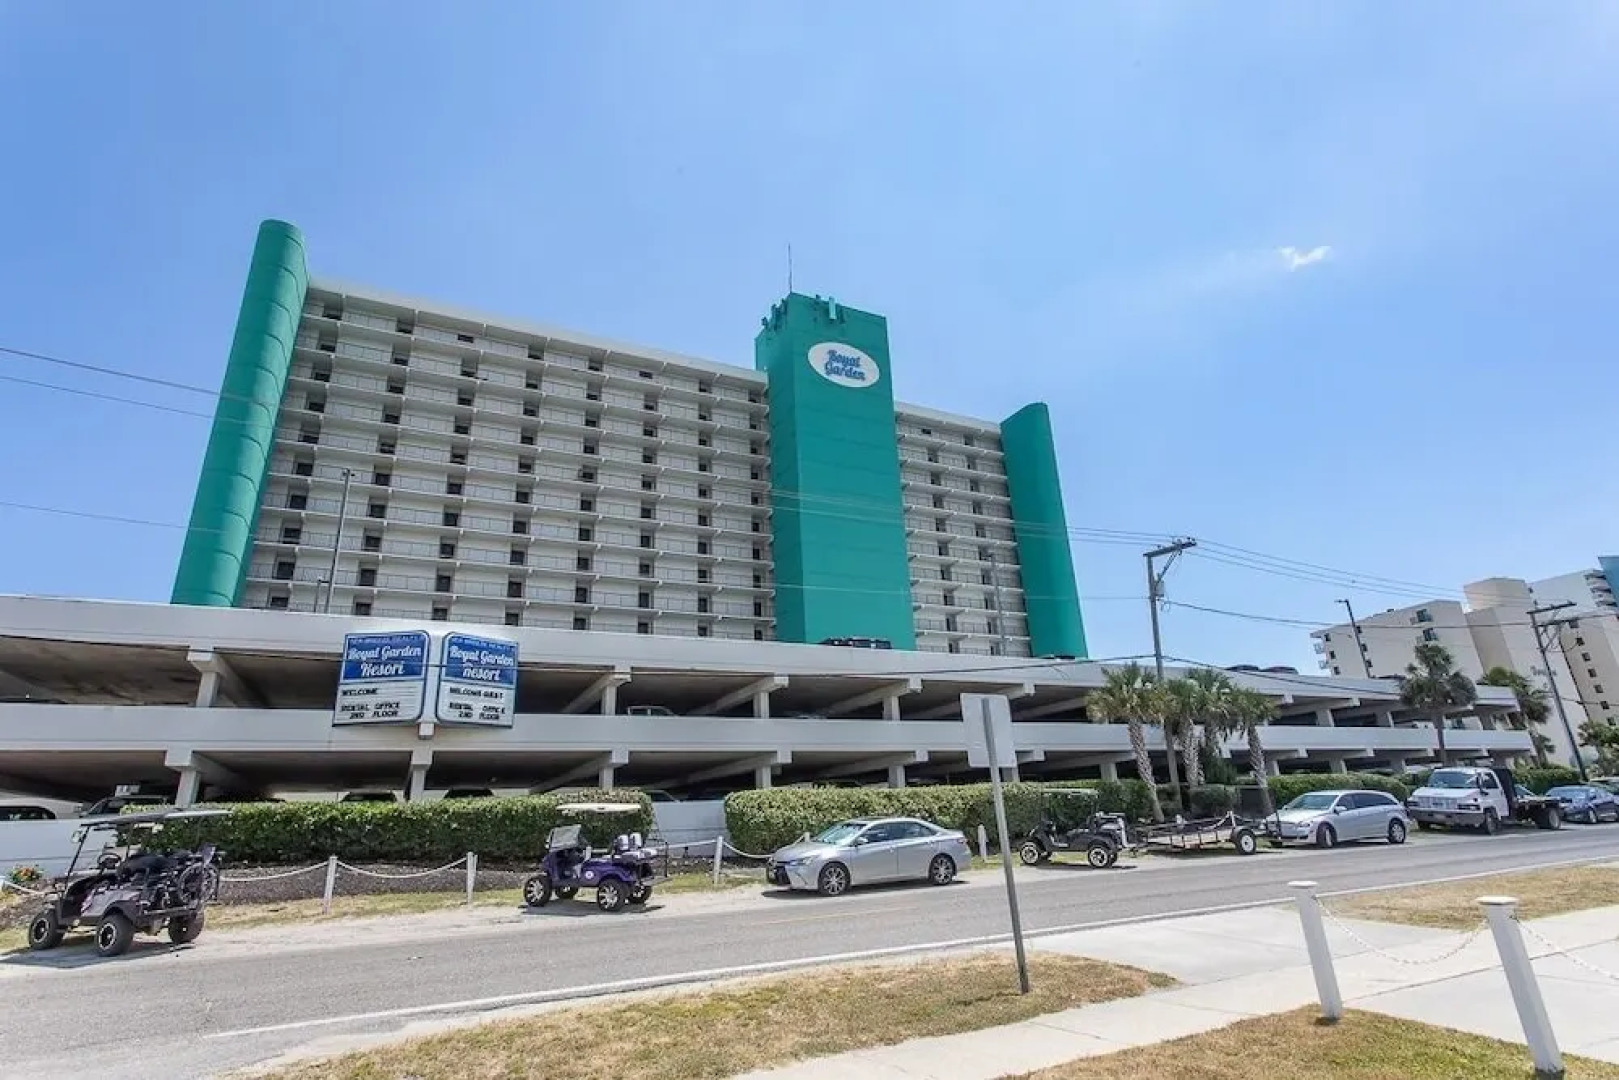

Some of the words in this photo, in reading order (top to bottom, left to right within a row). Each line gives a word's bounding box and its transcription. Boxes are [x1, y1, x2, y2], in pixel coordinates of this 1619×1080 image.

[827, 349, 861, 368] Royal
[824, 361, 866, 382] Garden
[348, 647, 380, 661] Royal
[382, 645, 421, 661] Garden
[450, 645, 480, 662] Royal
[480, 650, 514, 666] Garden
[361, 661, 405, 677] Resort
[463, 662, 501, 681] Resort
[342, 688, 378, 696] WELCOME
